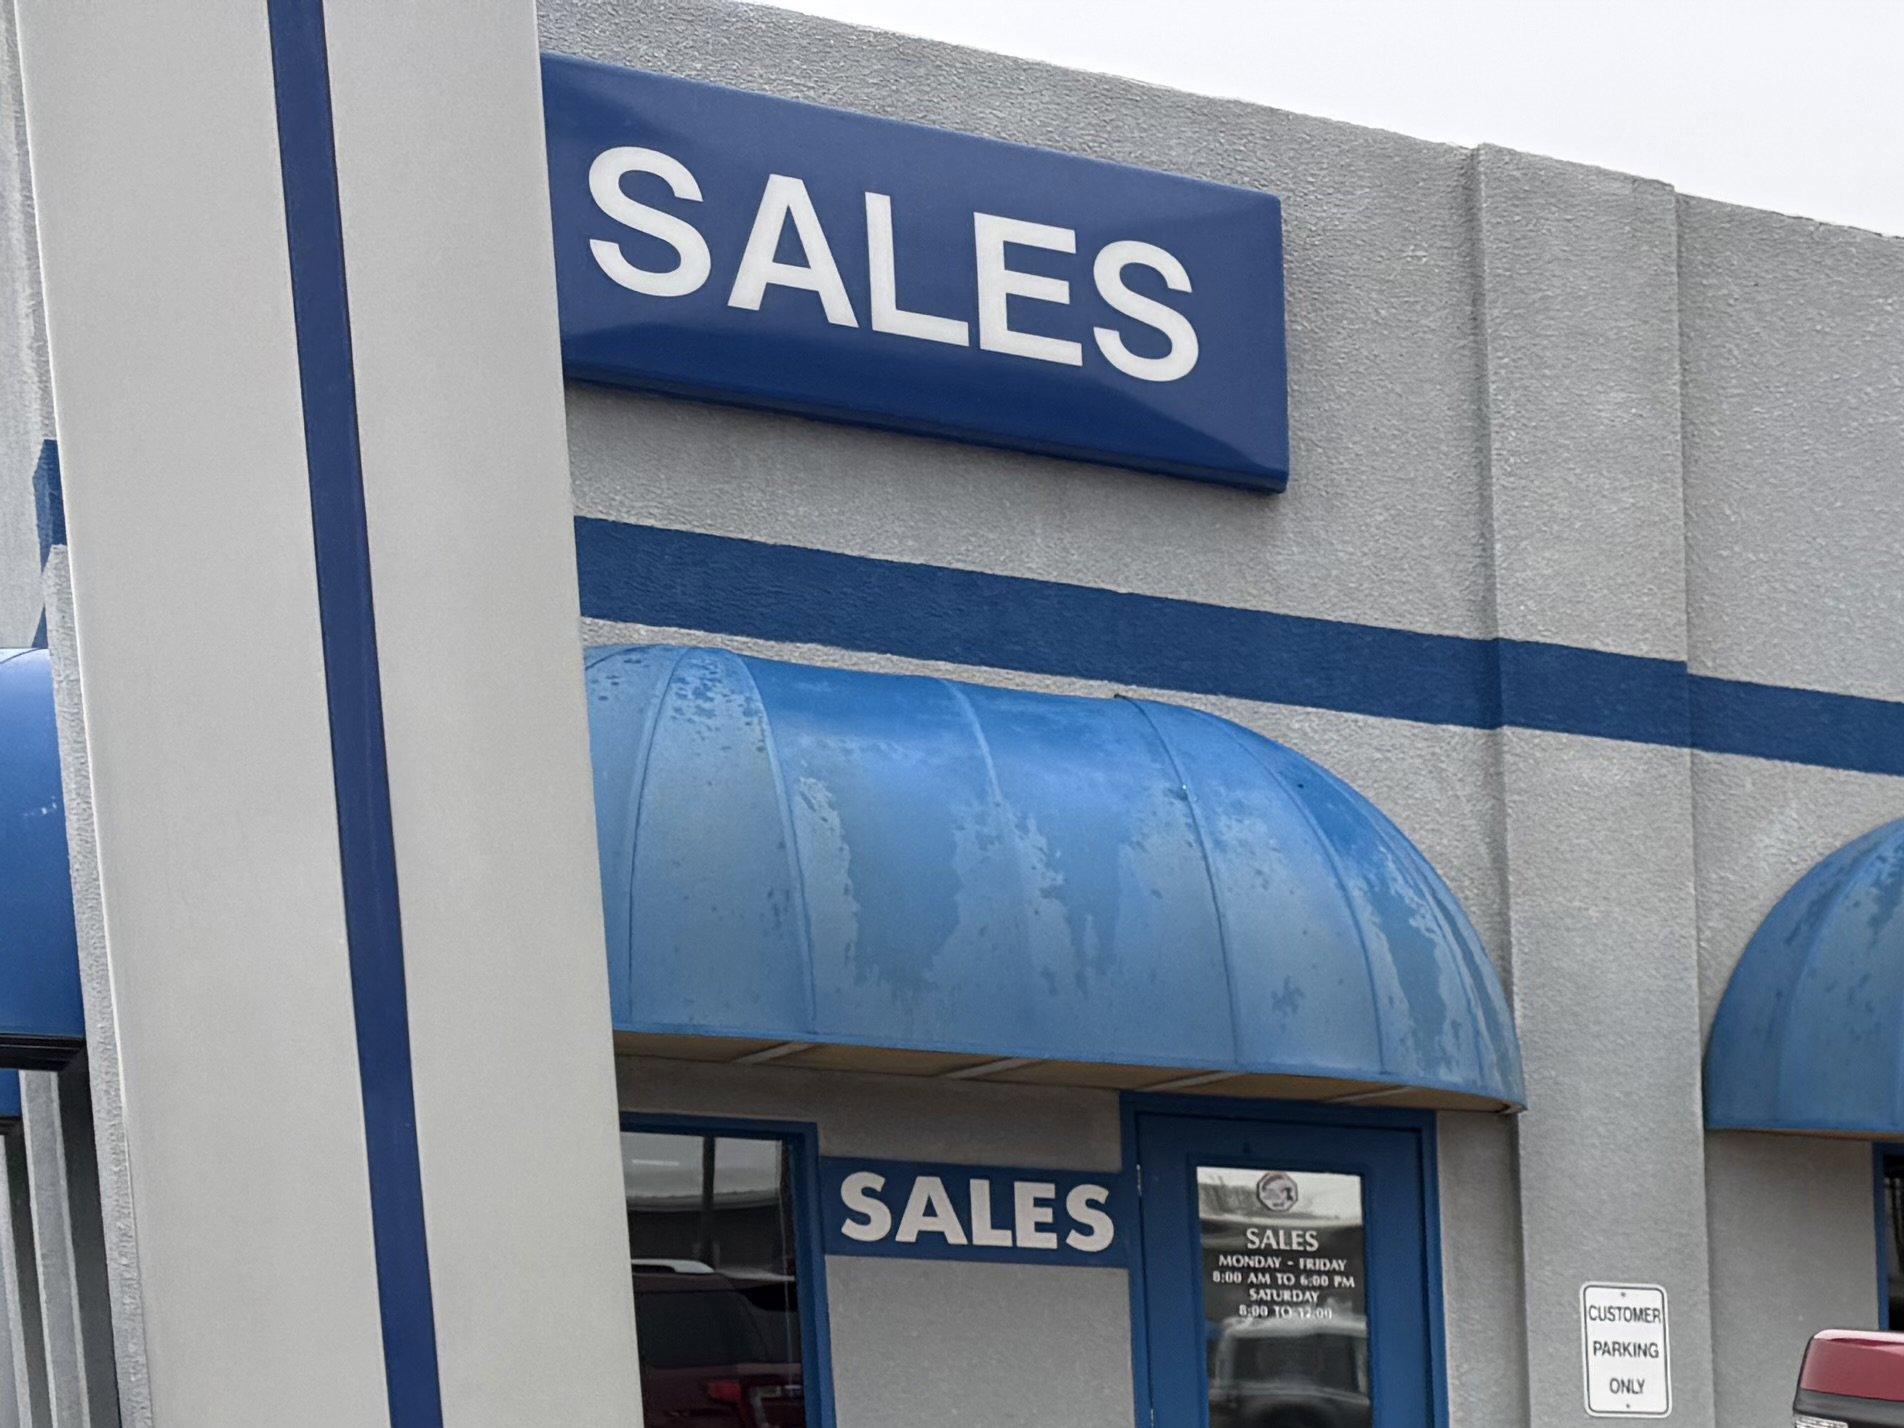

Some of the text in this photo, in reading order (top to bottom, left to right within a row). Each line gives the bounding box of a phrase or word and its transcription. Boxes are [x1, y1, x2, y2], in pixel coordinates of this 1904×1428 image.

[588, 146, 1200, 381] SALES
[840, 1171, 1115, 1252] SALES
[1246, 1228, 1319, 1252] SALES
[1218, 1254, 1281, 1269] MONDAY
[1299, 1258, 1347, 1271] FRIDAY
[1212, 1270, 1355, 1288] 8:00 AM TO 6:00 PM
[1249, 1288, 1320, 1303] SATURDAY
[1239, 1304, 1268, 1317] 8:00
[1273, 1305, 1292, 1318] TO
[1588, 1304, 1661, 1324] CUSTOMER
[1592, 1340, 1660, 1359] PARKING
[1609, 1377, 1645, 1394] ONLY
